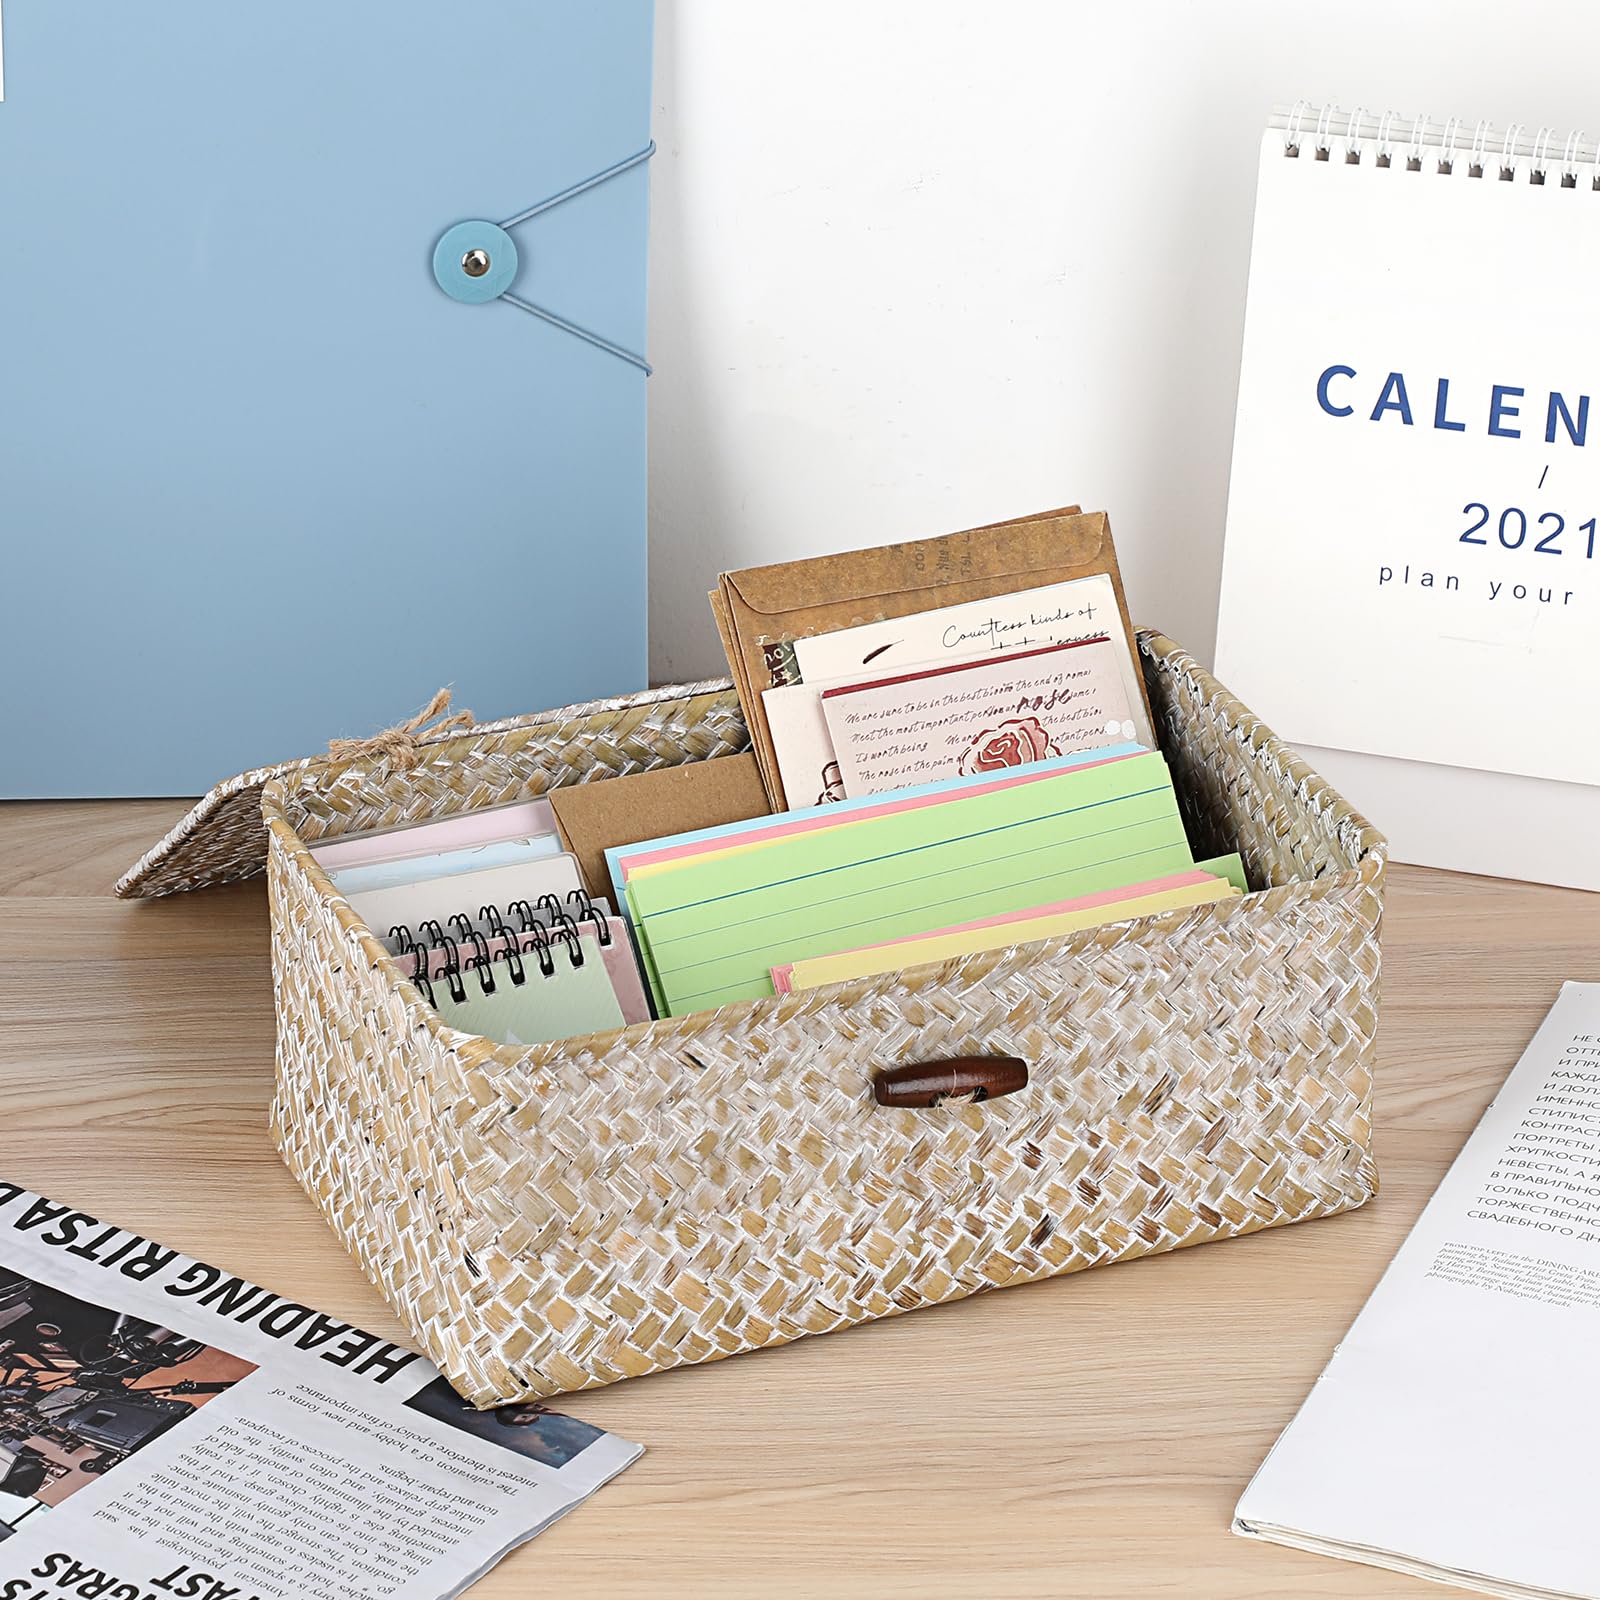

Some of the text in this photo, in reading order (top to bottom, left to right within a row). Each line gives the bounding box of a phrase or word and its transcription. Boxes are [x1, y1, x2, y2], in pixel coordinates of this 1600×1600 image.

[1316, 364, 1591, 447] CALEN
[1458, 502, 1597, 560] 2021
[1379, 565, 1574, 605] plan your
[1031, 608, 1074, 626] kinds
[1078, 602, 1097, 620] of
[1559, 1084, 1600, 1096] ДОЛ
[1528, 1107, 1600, 1123] СТИЛИС
[1513, 1132, 1595, 1150] ПОРТРЕТЫ
[1574, 1170, 1585, 1178] А
[1483, 1184, 1549, 1200] ТОЛЬКО
[1503, 1172, 1600, 1197] ПРАВИЛЬНО
[1467, 1210, 1574, 1236] СВАДЕБНОГО
[164, 1258, 421, 1385] HEADING
[216, 1425, 239, 1436] old
[296, 1384, 538, 1488] interest therefore policy first importance
[242, 1435, 262, 1446] the
[287, 1395, 518, 1496] The cultivation hobby and new forms
[191, 1443, 223, 1460] really
[299, 1444, 344, 1464] process
[178, 1454, 200, 1466] this
[210, 1469, 239, 1482] And
[309, 1463, 338, 1478] often
[342, 1463, 361, 1474] the
[151, 1473, 180, 1489] futile
[340, 1478, 366, 1491] and
[359, 1472, 385, 1485] and
[137, 1482, 158, 1495] this
[180, 1485, 211, 1501] more
[202, 1480, 252, 1505] insinuate
[217, 1441, 460, 1544] attended the illumination another field
[385, 1483, 424, 1502] relaxes
[417, 1483, 452, 1499] repair
[135, 1497, 152, 1509] let
[170, 1498, 204, 1513] mind
[211, 1498, 230, 1511] the
[308, 1494, 347, 1514] rightly
[424, 1499, 451, 1512] grip
[449, 1495, 475, 1506] and
[106, 1501, 141, 1517] mind
[154, 1506, 176, 1517] not
[204, 1511, 223, 1523] the
[253, 1500, 292, 1518] gently
[276, 1495, 334, 1523] convulsive
[448, 1509, 485, 1525] undue
[475, 1503, 498, 1516] tion
[141, 1516, 160, 1527] the
[175, 1515, 198, 1527] will
[224, 1520, 249, 1534] with
[256, 1518, 275, 1530] the
[289, 1516, 316, 1531] only
[336, 1522, 351, 1533] its
[363, 1519, 384, 1531] else
[199, 1526, 226, 1538] and
[250, 1532, 282, 1547] argue
[275, 1527, 323, 1549] stronger
[319, 1530, 340, 1541] can
[353, 1530, 377, 1544] into
[342, 1541, 368, 1555] One
[378, 1541, 400, 1552] else
[387, 1527, 447, 1555] something
[92, 1510, 288, 1600] American psychologist has said
[214, 1547, 233, 1558] the
[228, 1536, 287, 1565] something
[323, 1547, 345, 1563] The
[402, 1549, 432, 1566] thing
[297, 1551, 335, 1571] useless
[31, 1553, 158, 1600] GRAS
[250, 1562, 286, 1580] spasm
[400, 1564, 419, 1576] the
[150, 1565, 262, 1600] AST
[304, 1571, 335, 1588] hold
